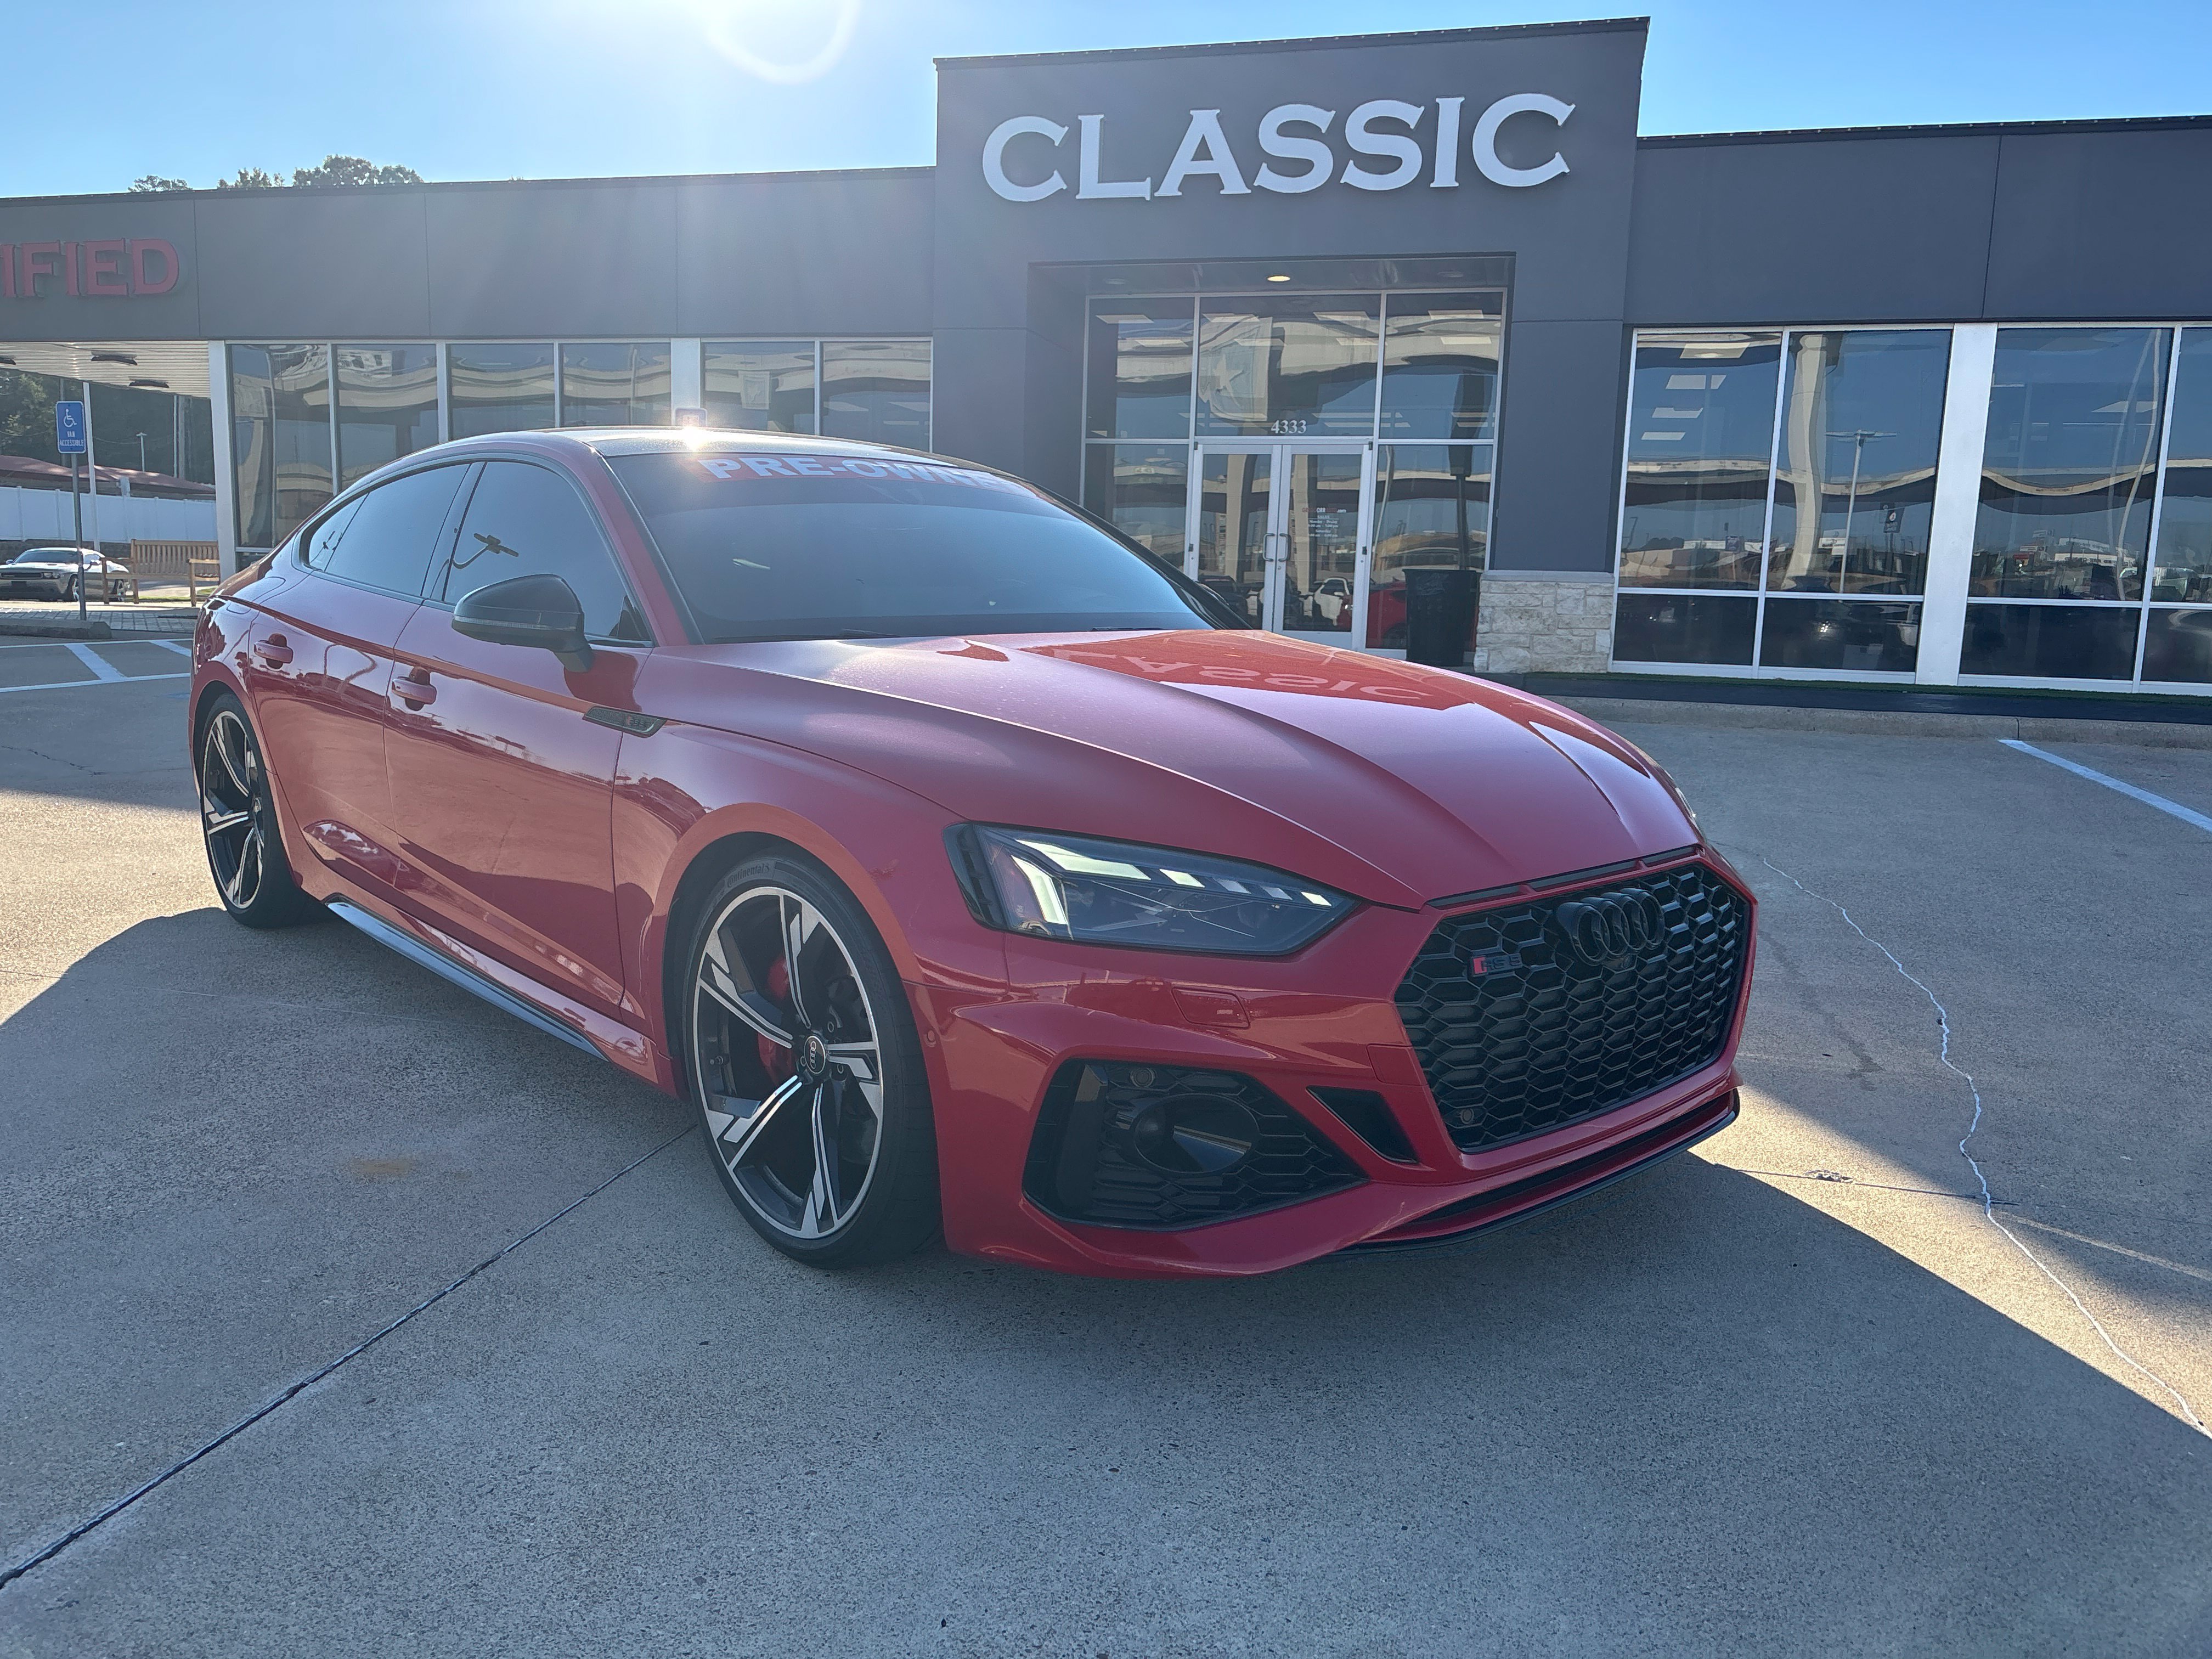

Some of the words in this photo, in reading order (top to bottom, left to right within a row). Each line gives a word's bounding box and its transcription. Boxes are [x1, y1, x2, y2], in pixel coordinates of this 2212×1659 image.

[982, 92, 1576, 202] CLASSIC
[0, 238, 179, 297] IFIED
[1271, 420, 1307, 434] 4333
